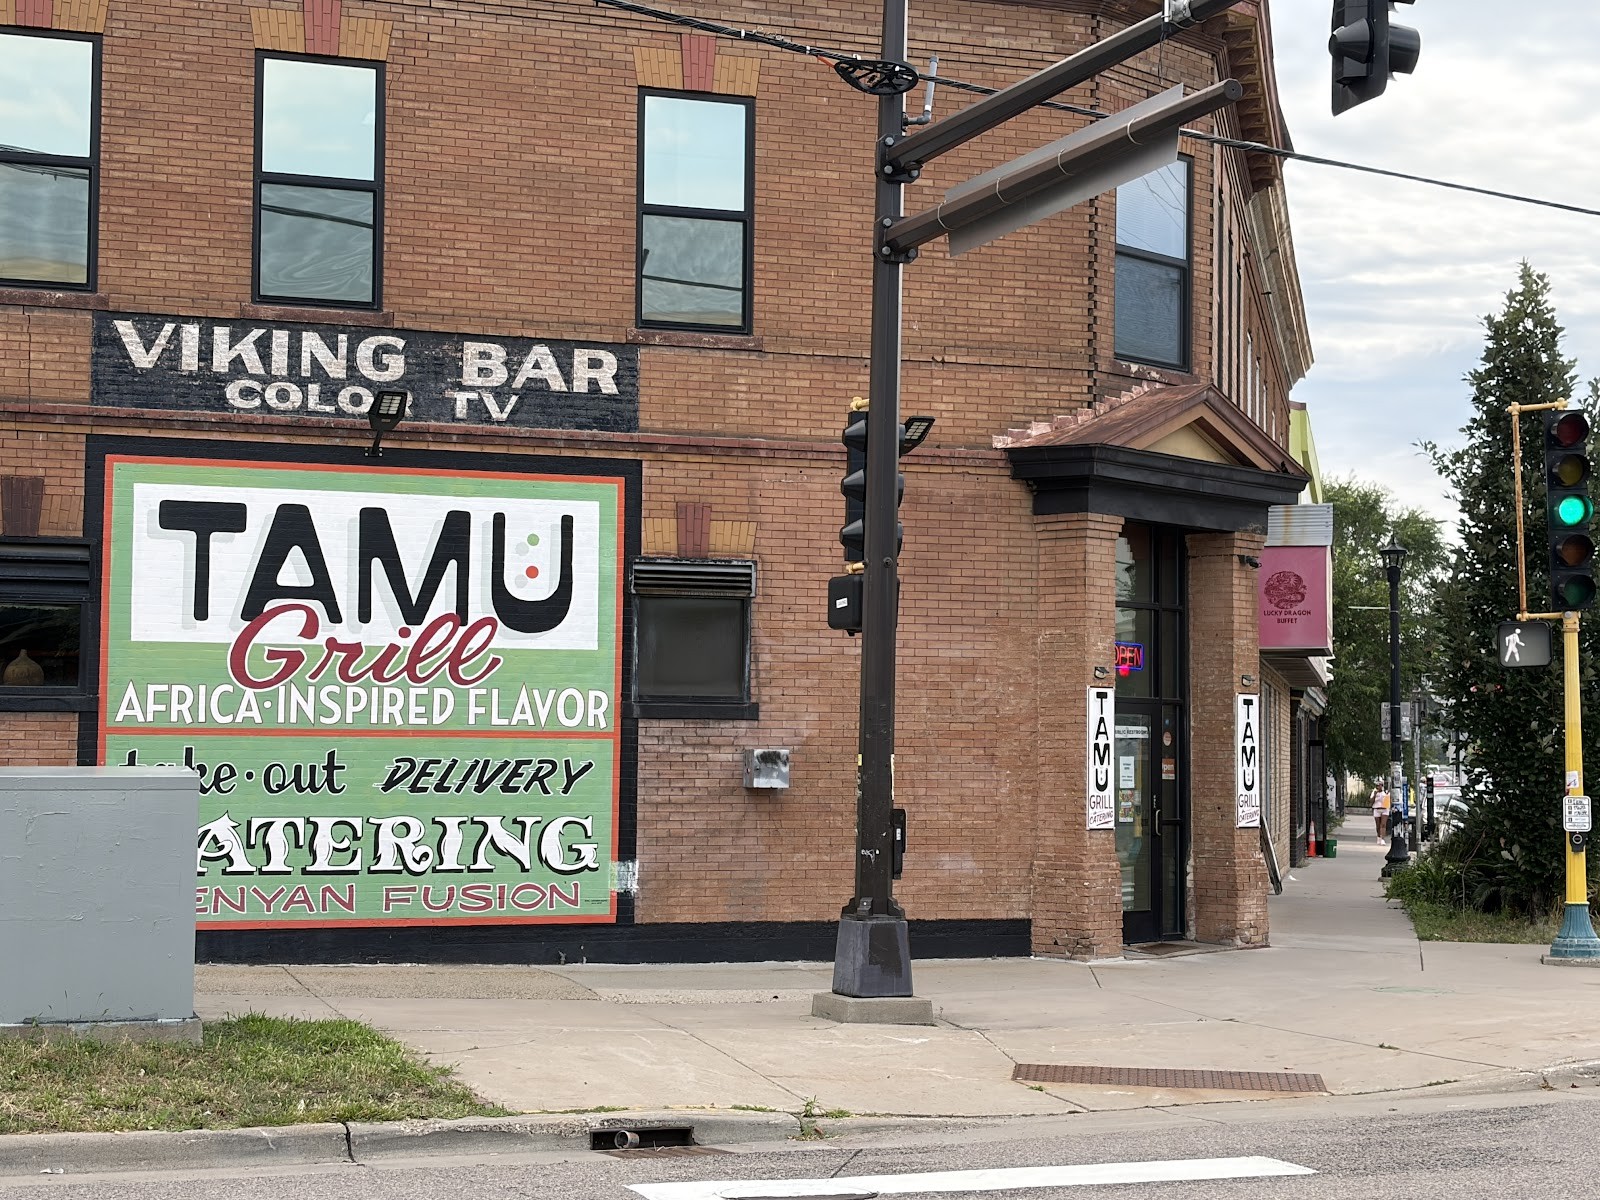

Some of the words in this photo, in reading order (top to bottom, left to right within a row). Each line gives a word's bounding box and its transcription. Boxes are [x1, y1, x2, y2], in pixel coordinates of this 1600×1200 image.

[113, 319, 406, 382] VIKING
[462, 340, 619, 395] BAR
[225, 378, 413, 418] COLO
[446, 389, 521, 422] TV
[157, 499, 574, 634] TAMU
[227, 603, 503, 690] Grill
[467, 681, 609, 730] FLAVOR
[1093, 691, 1111, 793] TAMU
[1241, 698, 1256, 792] TAMU
[376, 756, 595, 796] DELIVERY
[1090, 795, 1114, 810] GRILL
[1090, 810, 1114, 825] CATERING
[1238, 794, 1260, 808] GRILL
[197, 810, 601, 877] ATERING
[196, 882, 356, 914] NYAN
[383, 881, 581, 913] FUSION
